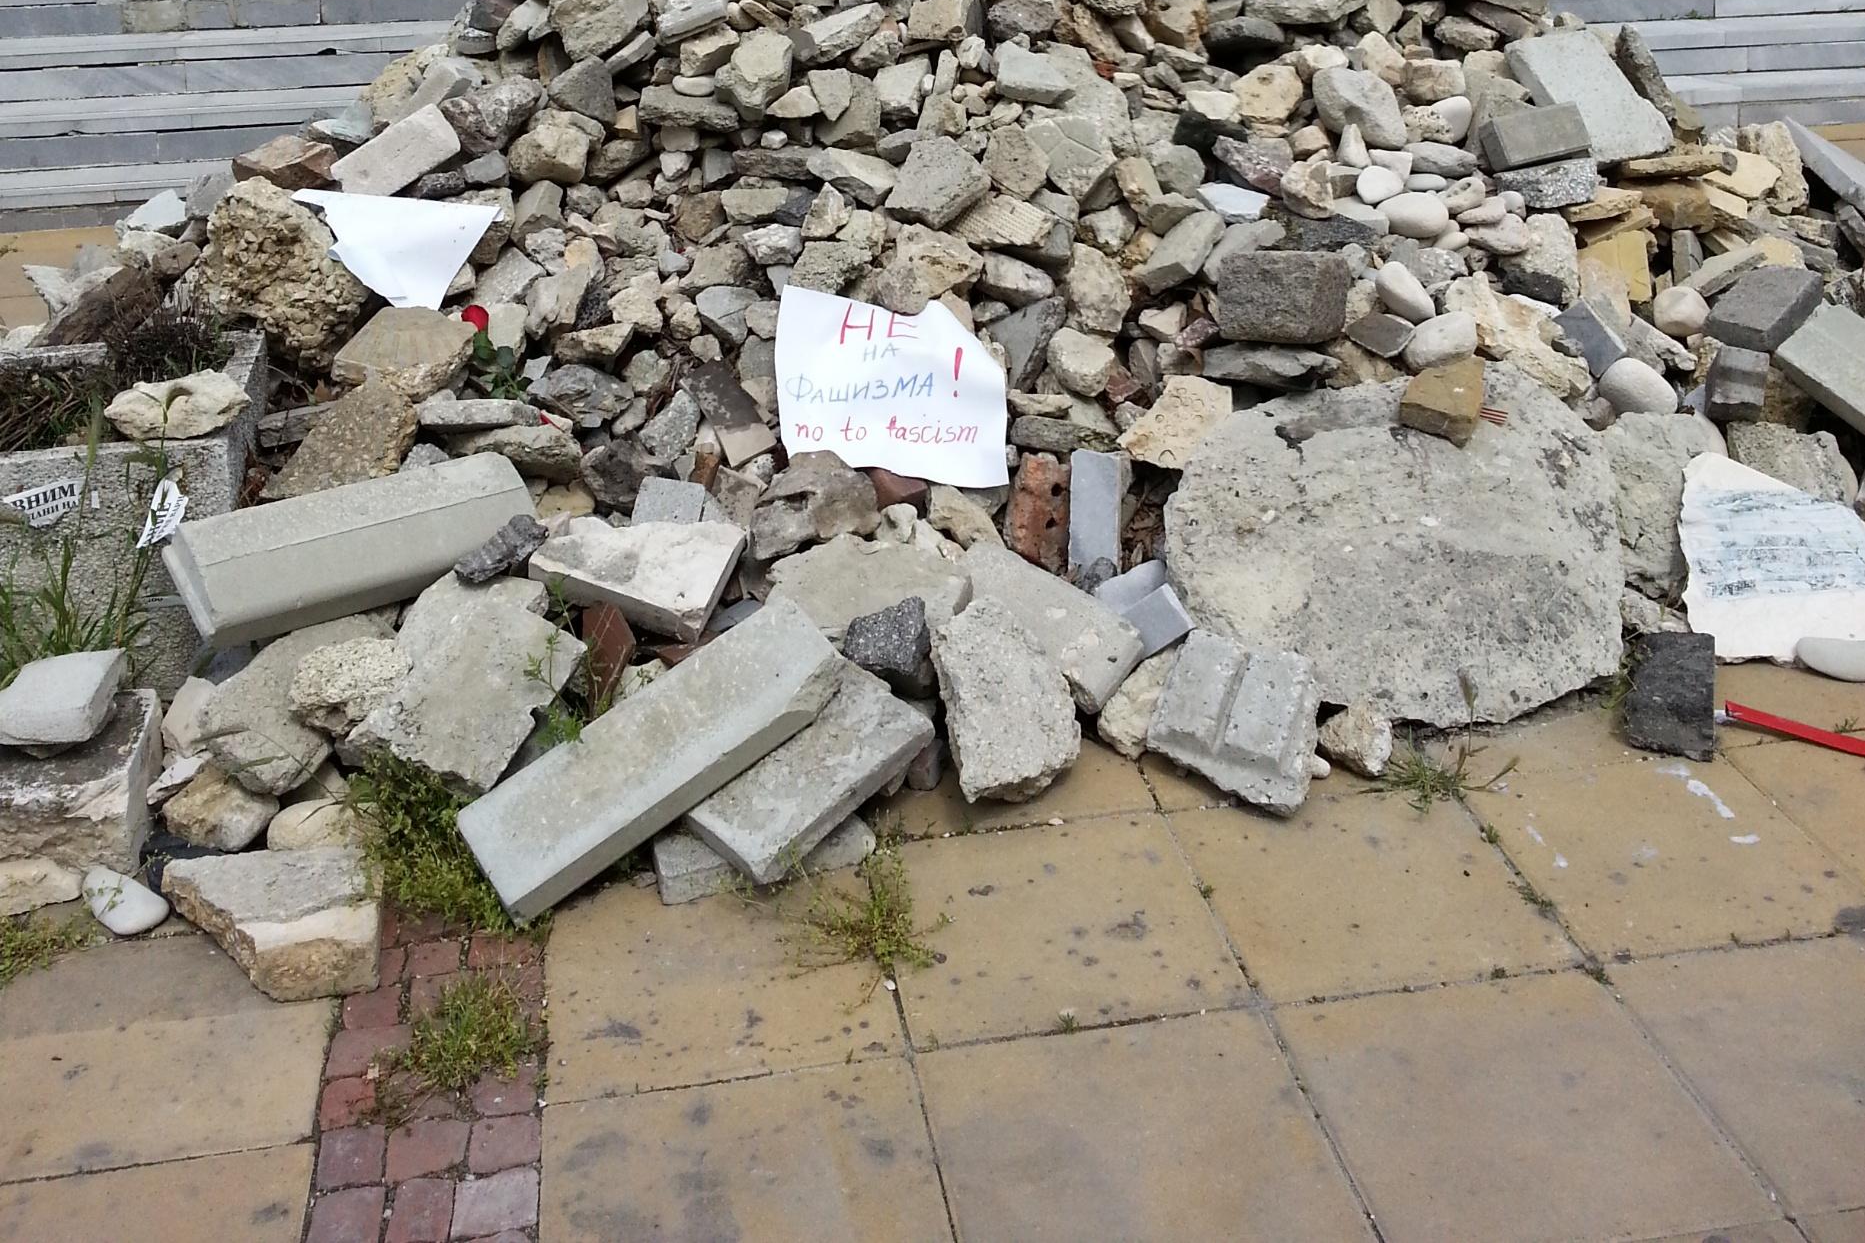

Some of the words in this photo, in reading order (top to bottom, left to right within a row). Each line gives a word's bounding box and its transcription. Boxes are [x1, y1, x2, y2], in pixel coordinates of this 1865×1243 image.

[839, 302, 920, 344] НЕ
[863, 342, 901, 362] НА
[795, 423, 823, 441] no
[840, 416, 867, 442] to
